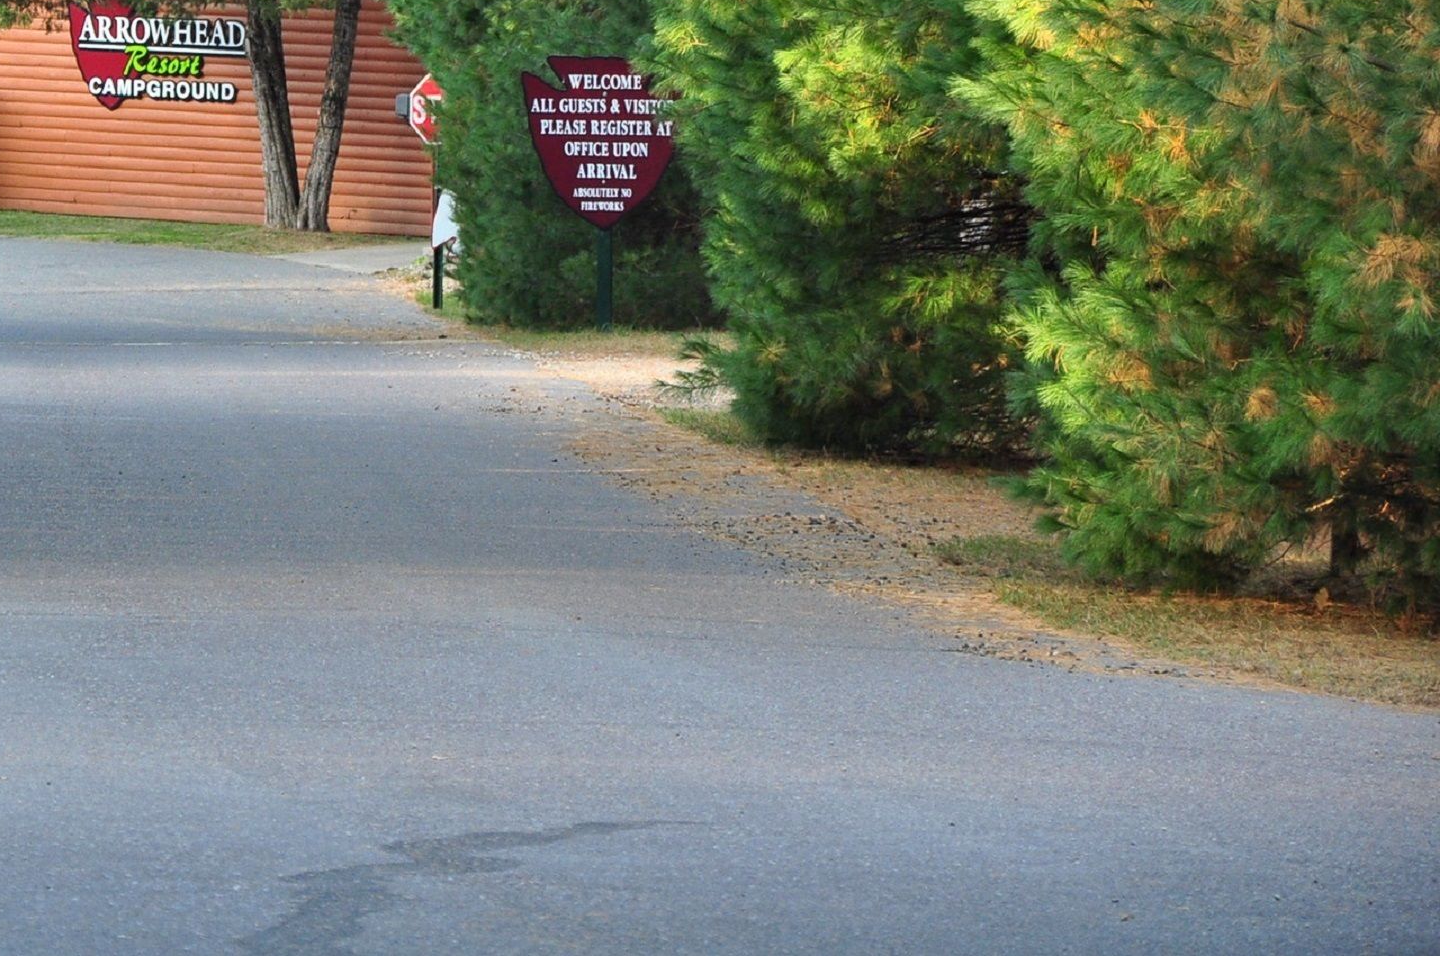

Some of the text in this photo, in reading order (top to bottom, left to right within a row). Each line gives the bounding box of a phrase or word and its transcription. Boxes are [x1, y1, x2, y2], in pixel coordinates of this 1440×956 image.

[78, 15, 246, 48] ARROWHEAD
[123, 45, 201, 76] Resort
[88, 77, 236, 101] CAMPGROUND
[568, 74, 642, 90] WELCOME
[531, 98, 556, 113] ALL
[559, 98, 607, 113] GUESTS
[610, 99, 621, 114] &
[540, 119, 674, 137] PLEASE REGISTER AT
[564, 141, 649, 158] OFFICE UPON
[576, 163, 637, 180] ARRIVAL
[573, 187, 632, 198] ABSOLUTELY NO
[581, 201, 625, 212] FIREWORKS
